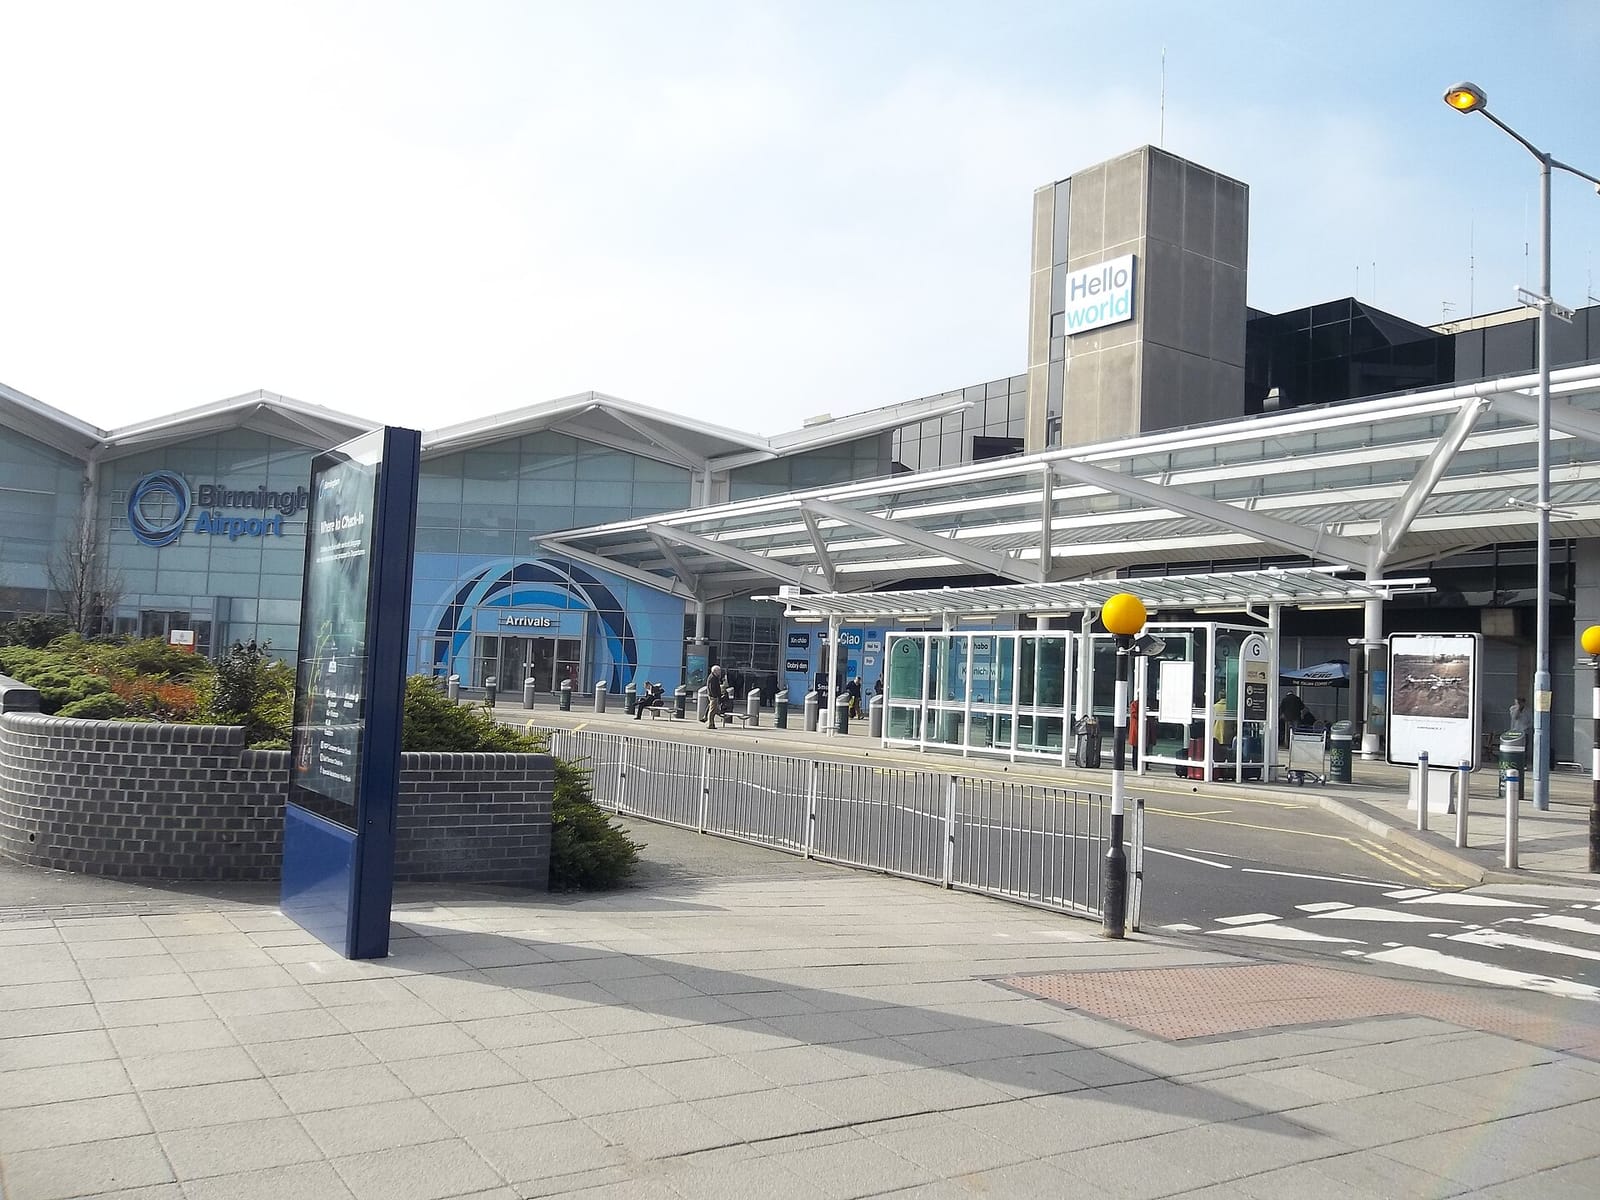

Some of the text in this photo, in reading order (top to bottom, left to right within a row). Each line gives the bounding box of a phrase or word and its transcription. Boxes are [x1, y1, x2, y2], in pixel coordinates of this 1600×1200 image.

[1071, 267, 1127, 301] Hello
[1067, 289, 1128, 328] world
[198, 484, 309, 517] Birmingh
[194, 511, 283, 542] Airport
[506, 615, 550, 628] Arrivals
[840, 632, 860, 645] Ciao
[902, 644, 909, 654] G
[1252, 643, 1260, 656] G
[817, 684, 840, 692] Smog
